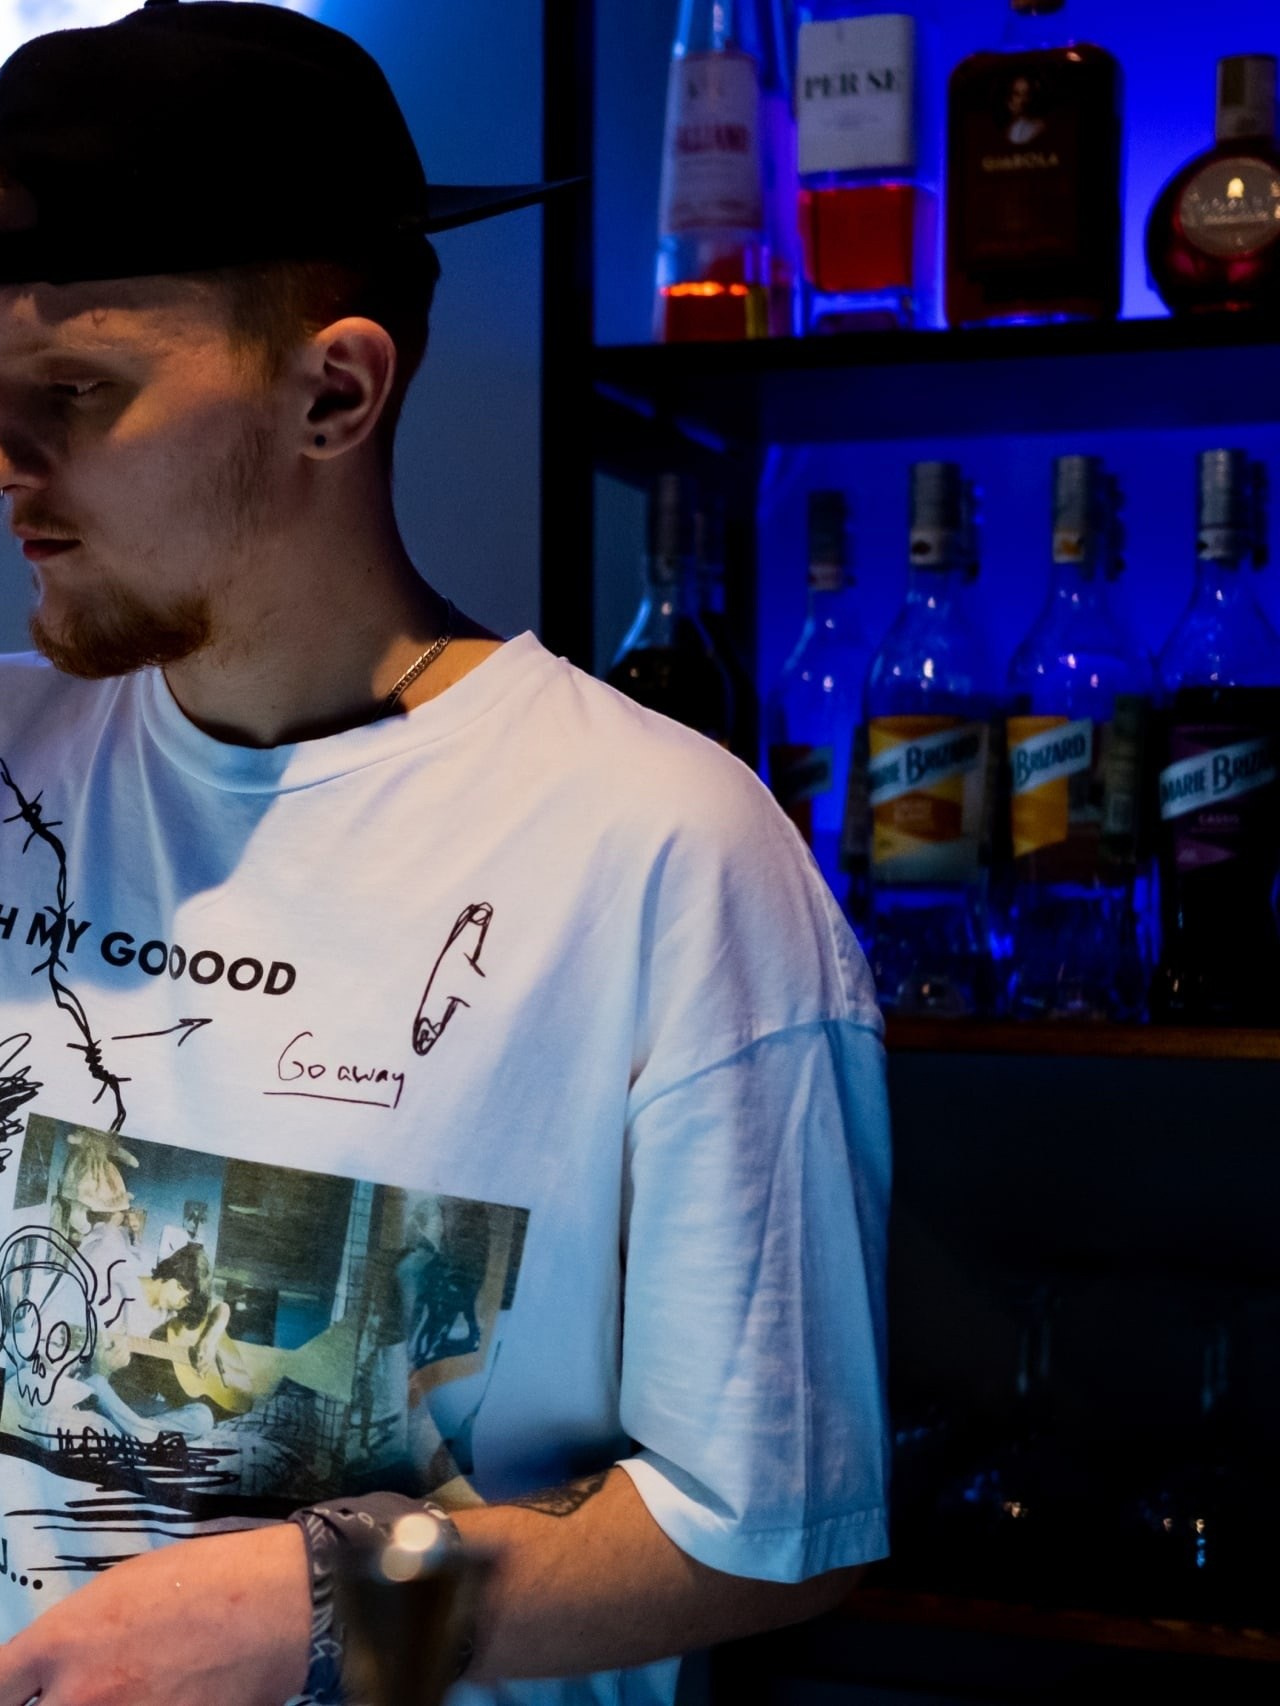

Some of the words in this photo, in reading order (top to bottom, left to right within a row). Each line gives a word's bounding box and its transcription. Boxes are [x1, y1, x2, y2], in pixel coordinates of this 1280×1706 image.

[804, 71, 859, 99] PER
[1014, 732, 1087, 788] BRIZARD
[1160, 767, 1207, 806] MARIE
[27, 910, 91, 955] MY
[278, 1032, 329, 1083] Go
[336, 1064, 405, 1108] away
